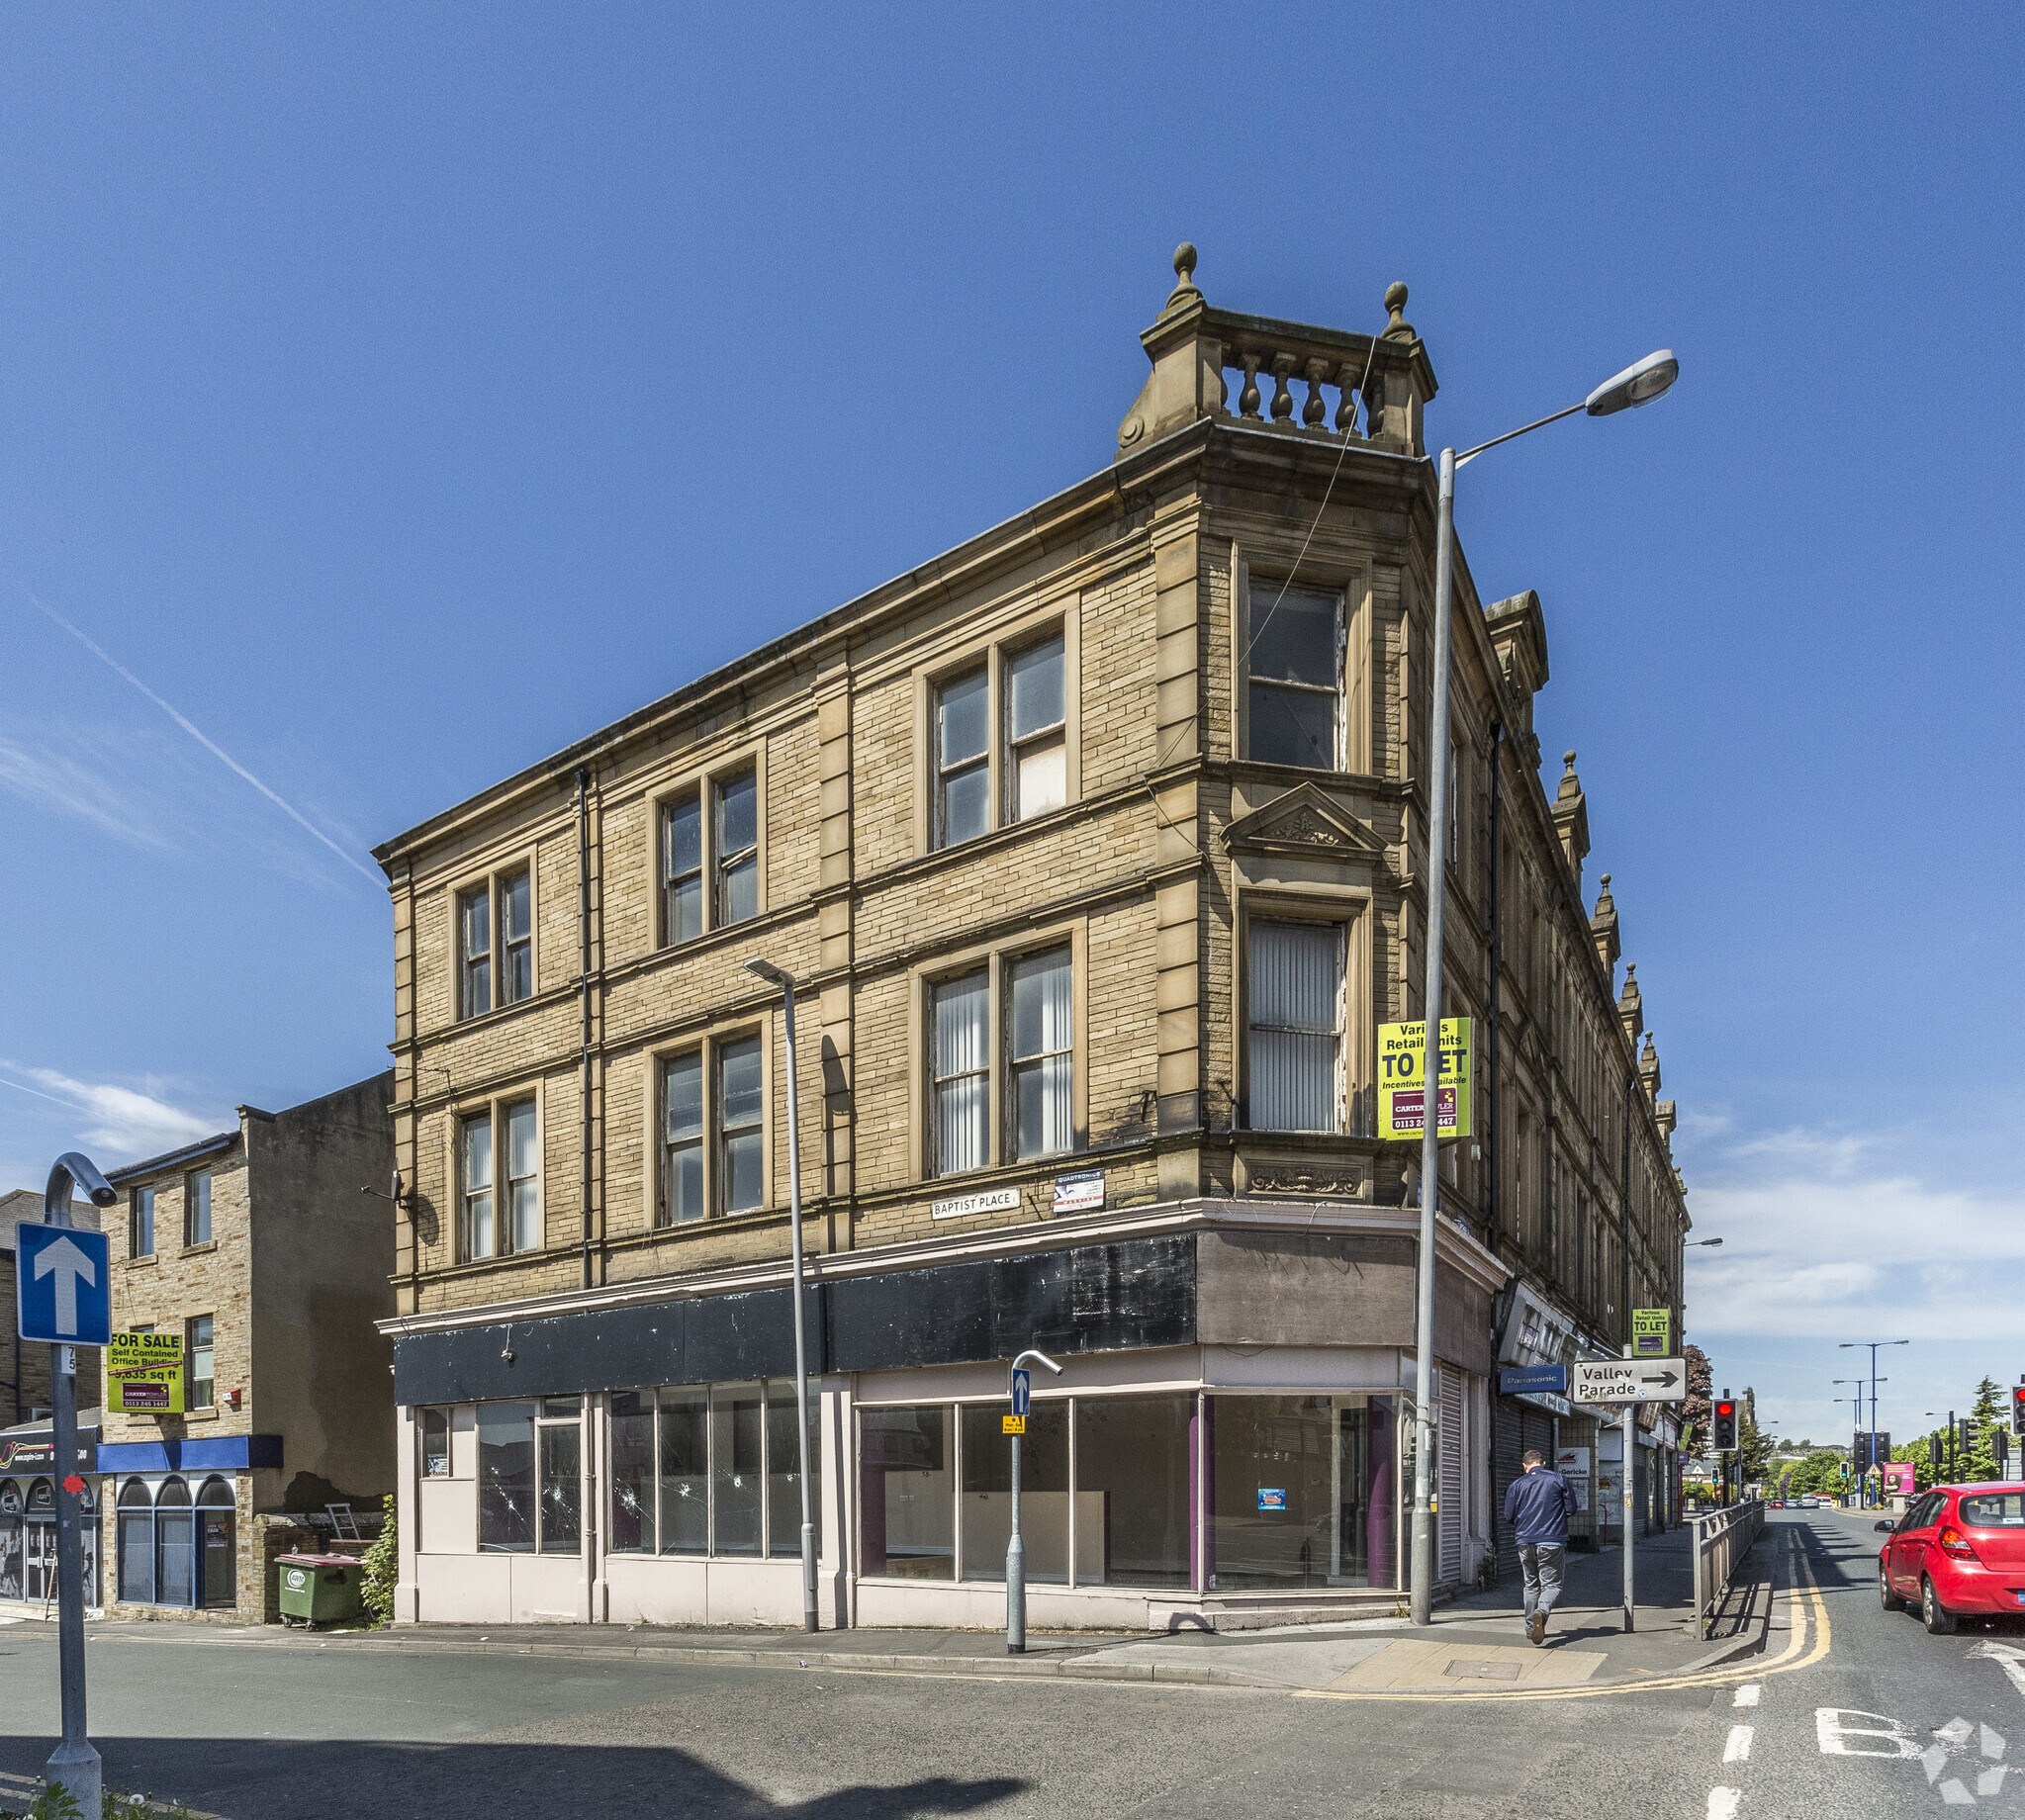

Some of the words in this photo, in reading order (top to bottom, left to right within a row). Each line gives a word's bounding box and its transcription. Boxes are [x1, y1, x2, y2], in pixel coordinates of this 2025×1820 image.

[1400, 1024, 1448, 1036] Varis
[1386, 1037, 1424, 1050] Retail
[1438, 1035, 1462, 1046] nits
[1382, 1052, 1415, 1077] TO
[1424, 1048, 1467, 1075] ET
[1382, 1079, 1425, 1089] Incentives
[1438, 1076, 1466, 1085] ailable
[1395, 1120, 1415, 1129] 0113
[935, 1199, 976, 1215] BAPTIST
[979, 1193, 1010, 1208] PLACE
[1634, 1321, 1647, 1331] TO
[1649, 1321, 1667, 1331] LET
[111, 1334, 138, 1347] FOR
[142, 1335, 180, 1348] SALE
[133, 1349, 178, 1358] Contained
[112, 1357, 138, 1366] Office
[150, 1371, 164, 1382] sq
[167, 1370, 177, 1380] ft
[1507, 1374, 1557, 1385] Panasonic
[1583, 1368, 1633, 1380] Valley
[1579, 1383, 1635, 1396] Parade
